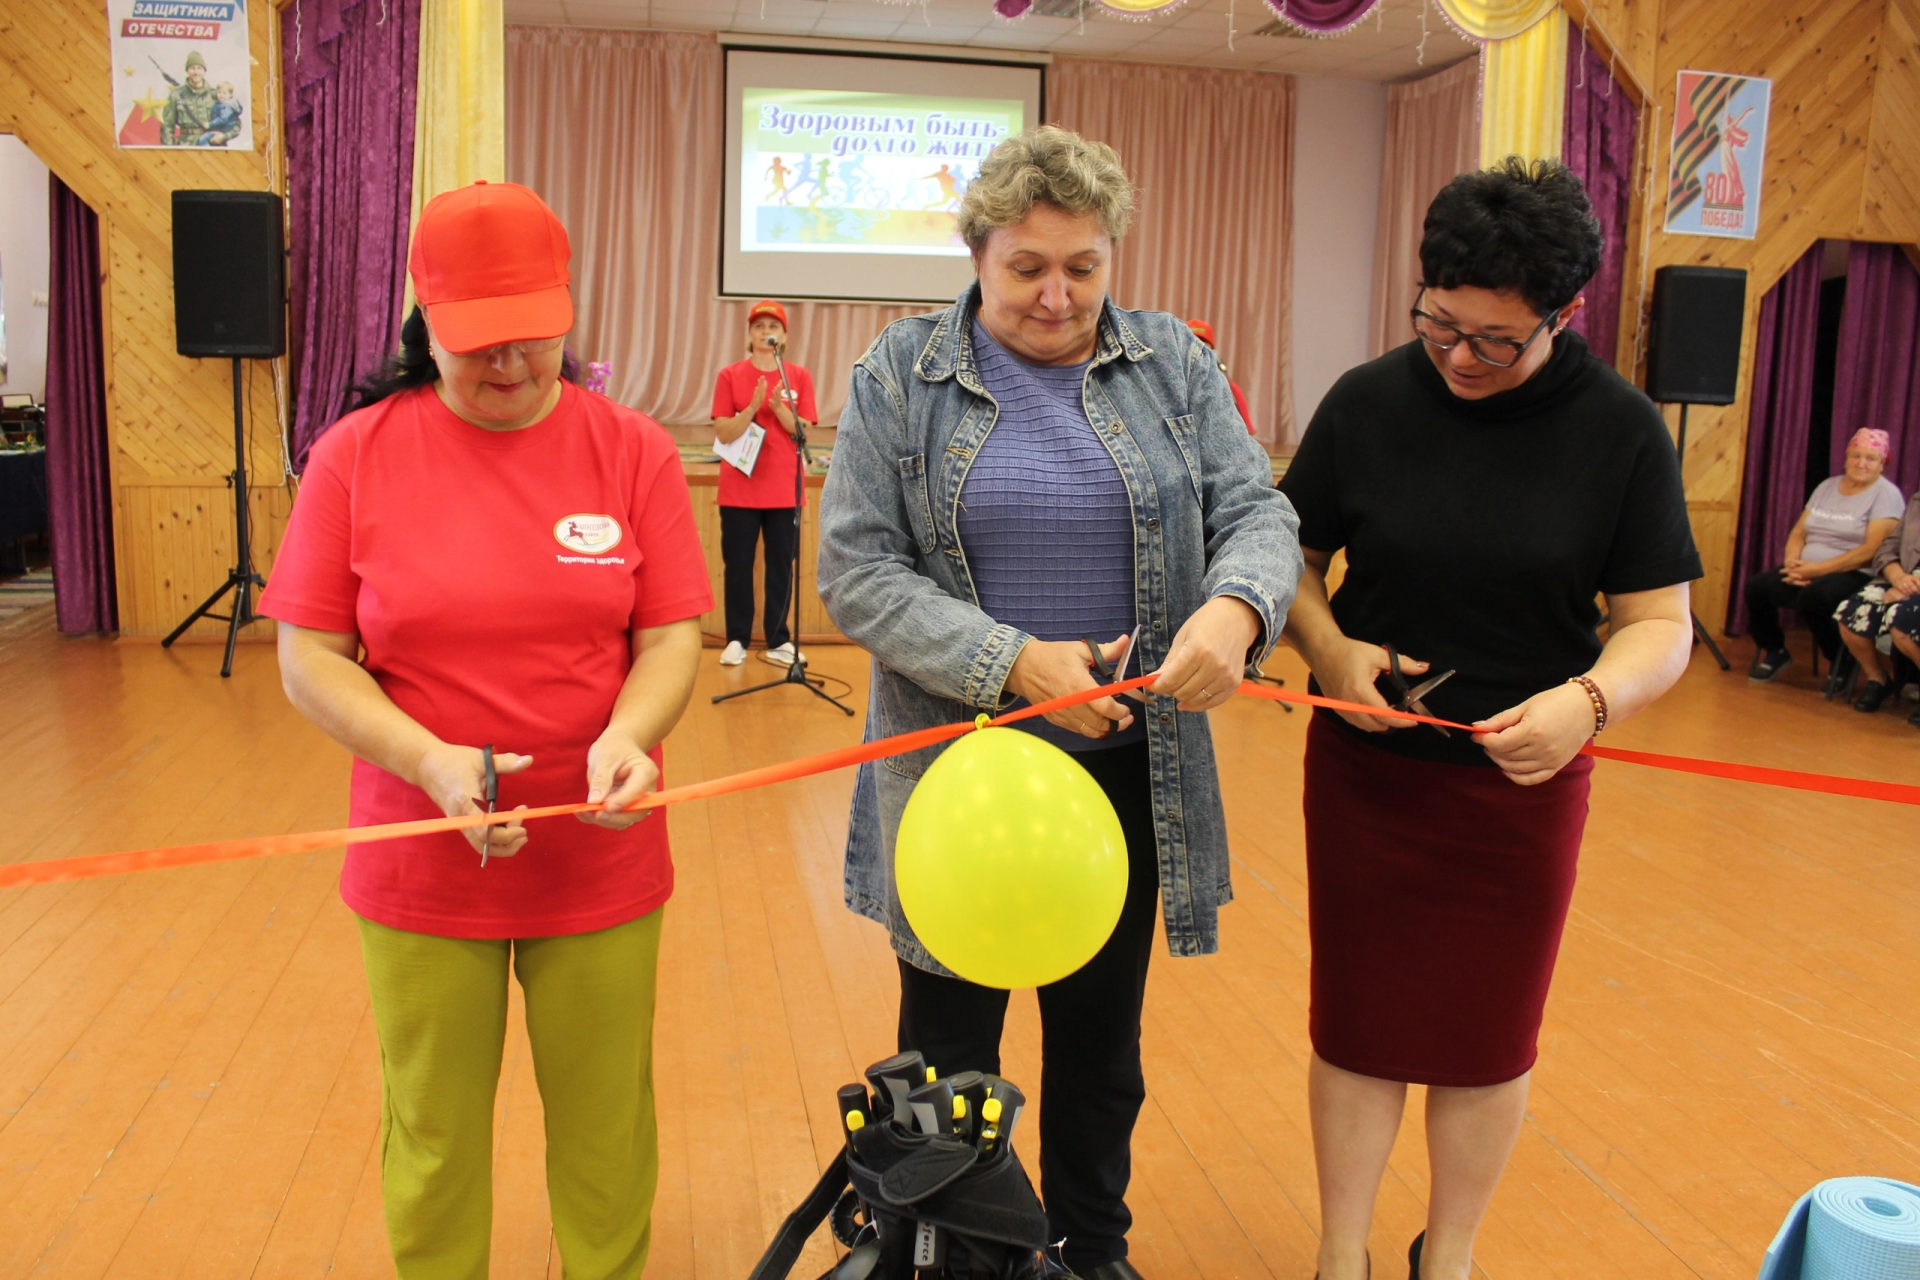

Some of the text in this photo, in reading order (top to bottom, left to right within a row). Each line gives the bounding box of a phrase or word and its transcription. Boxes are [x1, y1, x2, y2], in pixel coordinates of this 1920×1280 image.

[134, 3, 228, 18] ЗАЩИТНИКА
[128, 22, 215, 37] ОТЕЧЕСТВА
[760, 104, 915, 135] Здоровым
[832, 134, 916, 157] долго
[1704, 172, 1727, 204] 80
[1701, 211, 1744, 229] ПОБЕДА!
[556, 554, 596, 564] Территория
